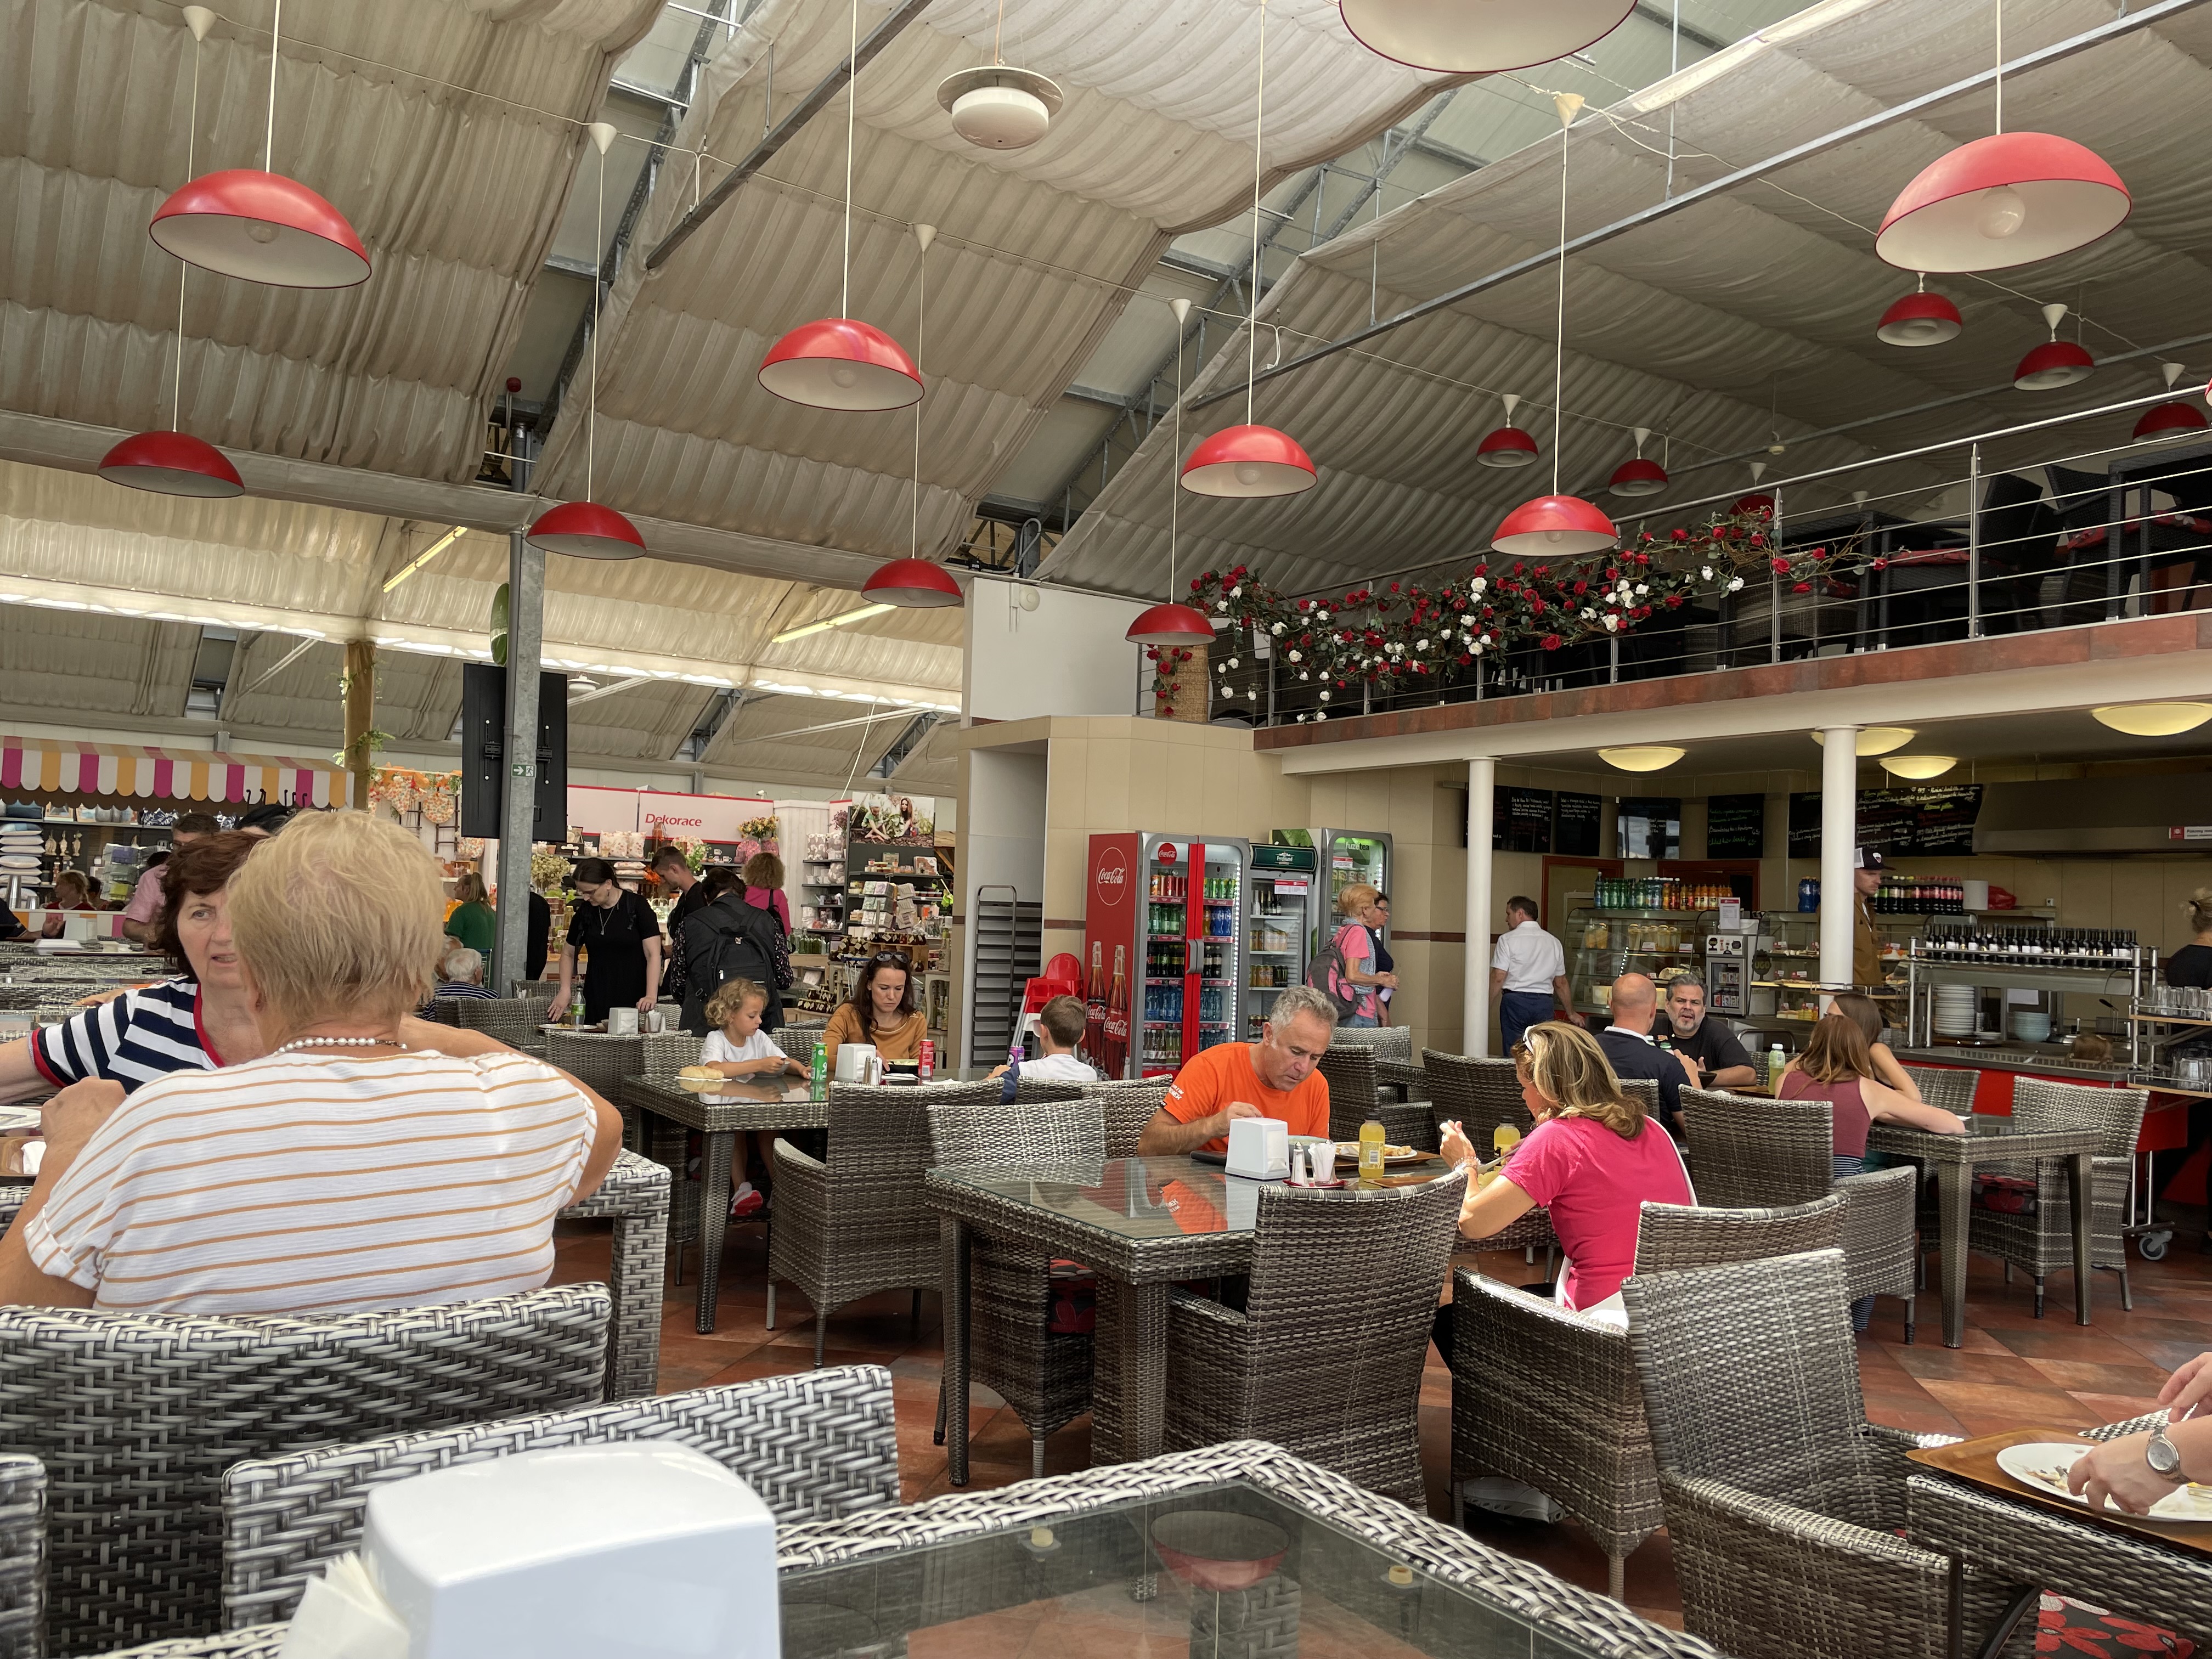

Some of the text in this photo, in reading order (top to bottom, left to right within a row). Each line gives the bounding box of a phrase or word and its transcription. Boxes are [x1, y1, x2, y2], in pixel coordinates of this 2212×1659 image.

[645, 814, 702, 827] Dekorace
[1159, 850, 1176, 858] Coca-Cola
[1098, 867, 1126, 884] Coca-Cola
[1754, 961, 1770, 969] UGO
[1086, 1005, 1107, 1020] Coca-Cola
[1103, 1016, 1128, 1037] Coca-Cola
